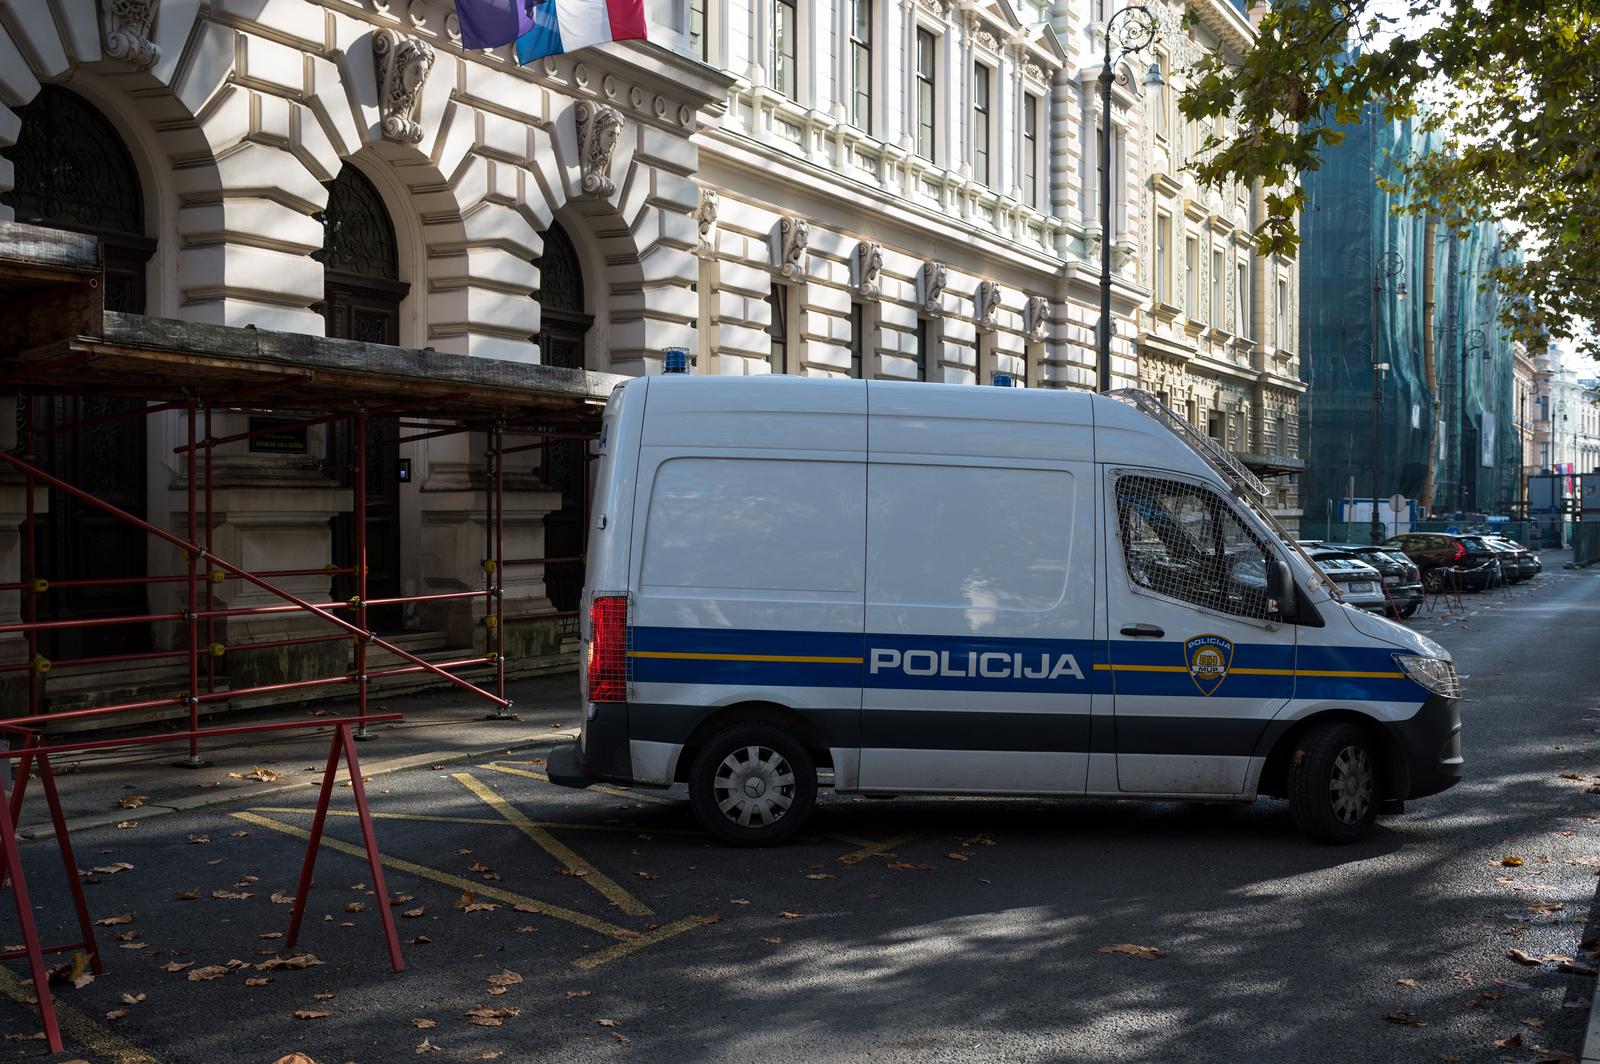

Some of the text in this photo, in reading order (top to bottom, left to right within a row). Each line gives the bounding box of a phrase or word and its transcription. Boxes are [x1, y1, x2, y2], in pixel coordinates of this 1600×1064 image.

[1188, 637, 1231, 650] POLICIJA
[869, 648, 1085, 680] POLICIJA
[1199, 655, 1218, 666] RH
